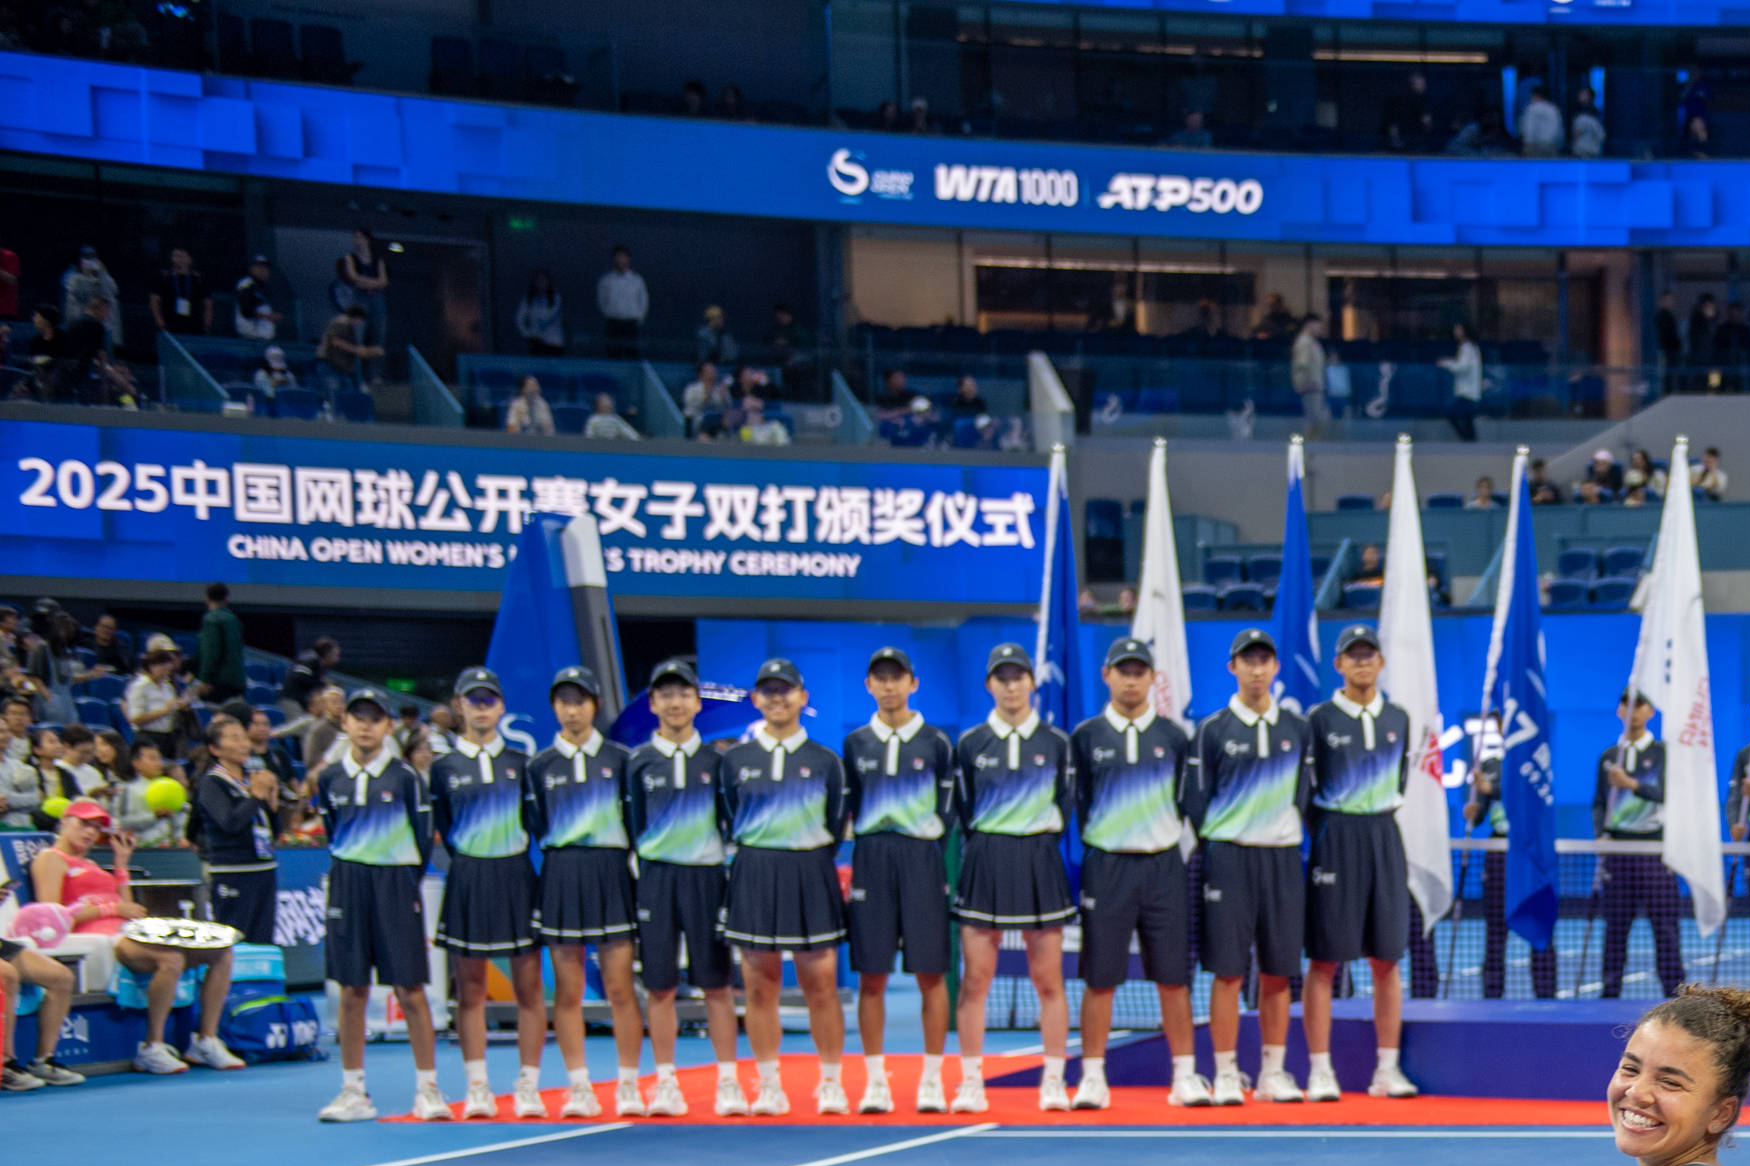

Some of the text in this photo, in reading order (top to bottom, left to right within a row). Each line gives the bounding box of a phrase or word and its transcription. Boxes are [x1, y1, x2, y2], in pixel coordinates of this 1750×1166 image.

[228, 534, 308, 562] CHINA
[310, 538, 385, 565] OPEN
[387, 540, 506, 568] WOMEN'S
[628, 548, 727, 576] TROPHY
[730, 551, 862, 578] CEREMONY
